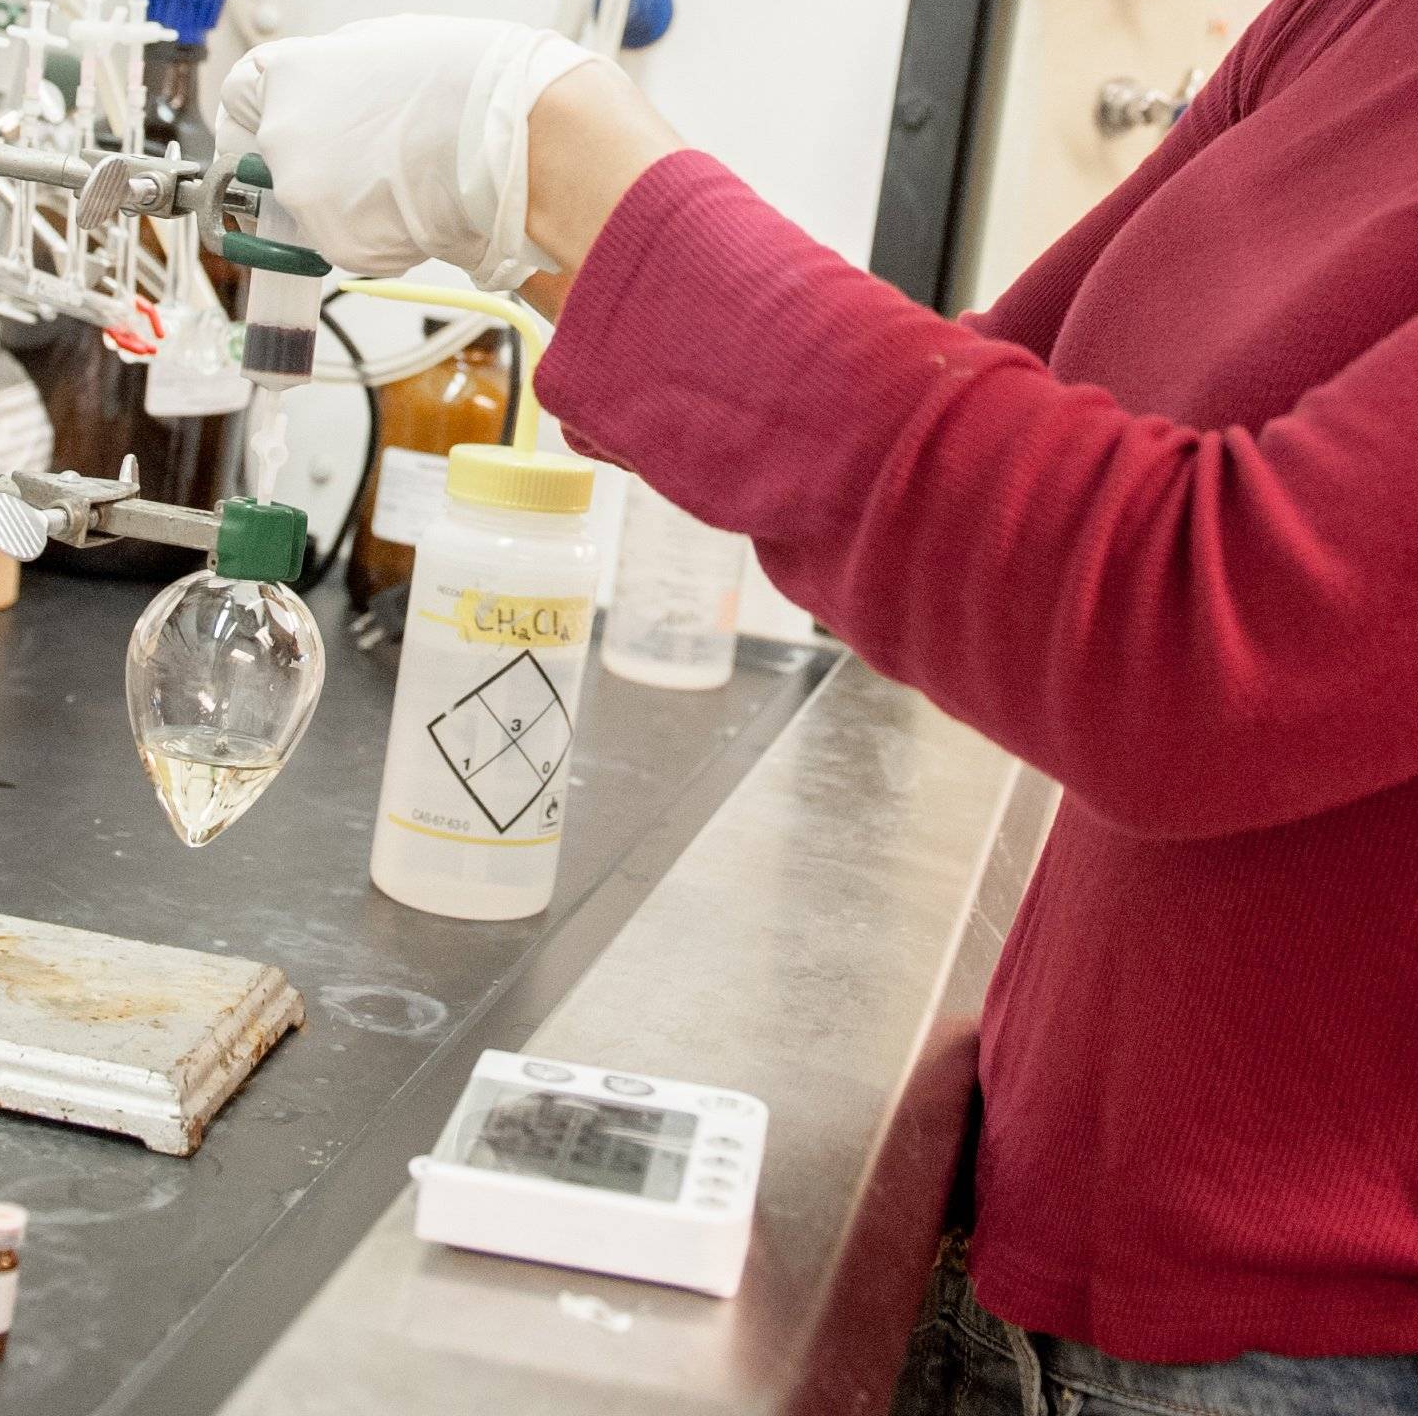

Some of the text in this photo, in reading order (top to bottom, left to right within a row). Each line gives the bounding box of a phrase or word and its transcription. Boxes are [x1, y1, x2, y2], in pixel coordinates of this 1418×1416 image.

[510, 718, 522, 732] 3
[462, 757, 471, 771] 1
[541, 760, 551, 774] 0
